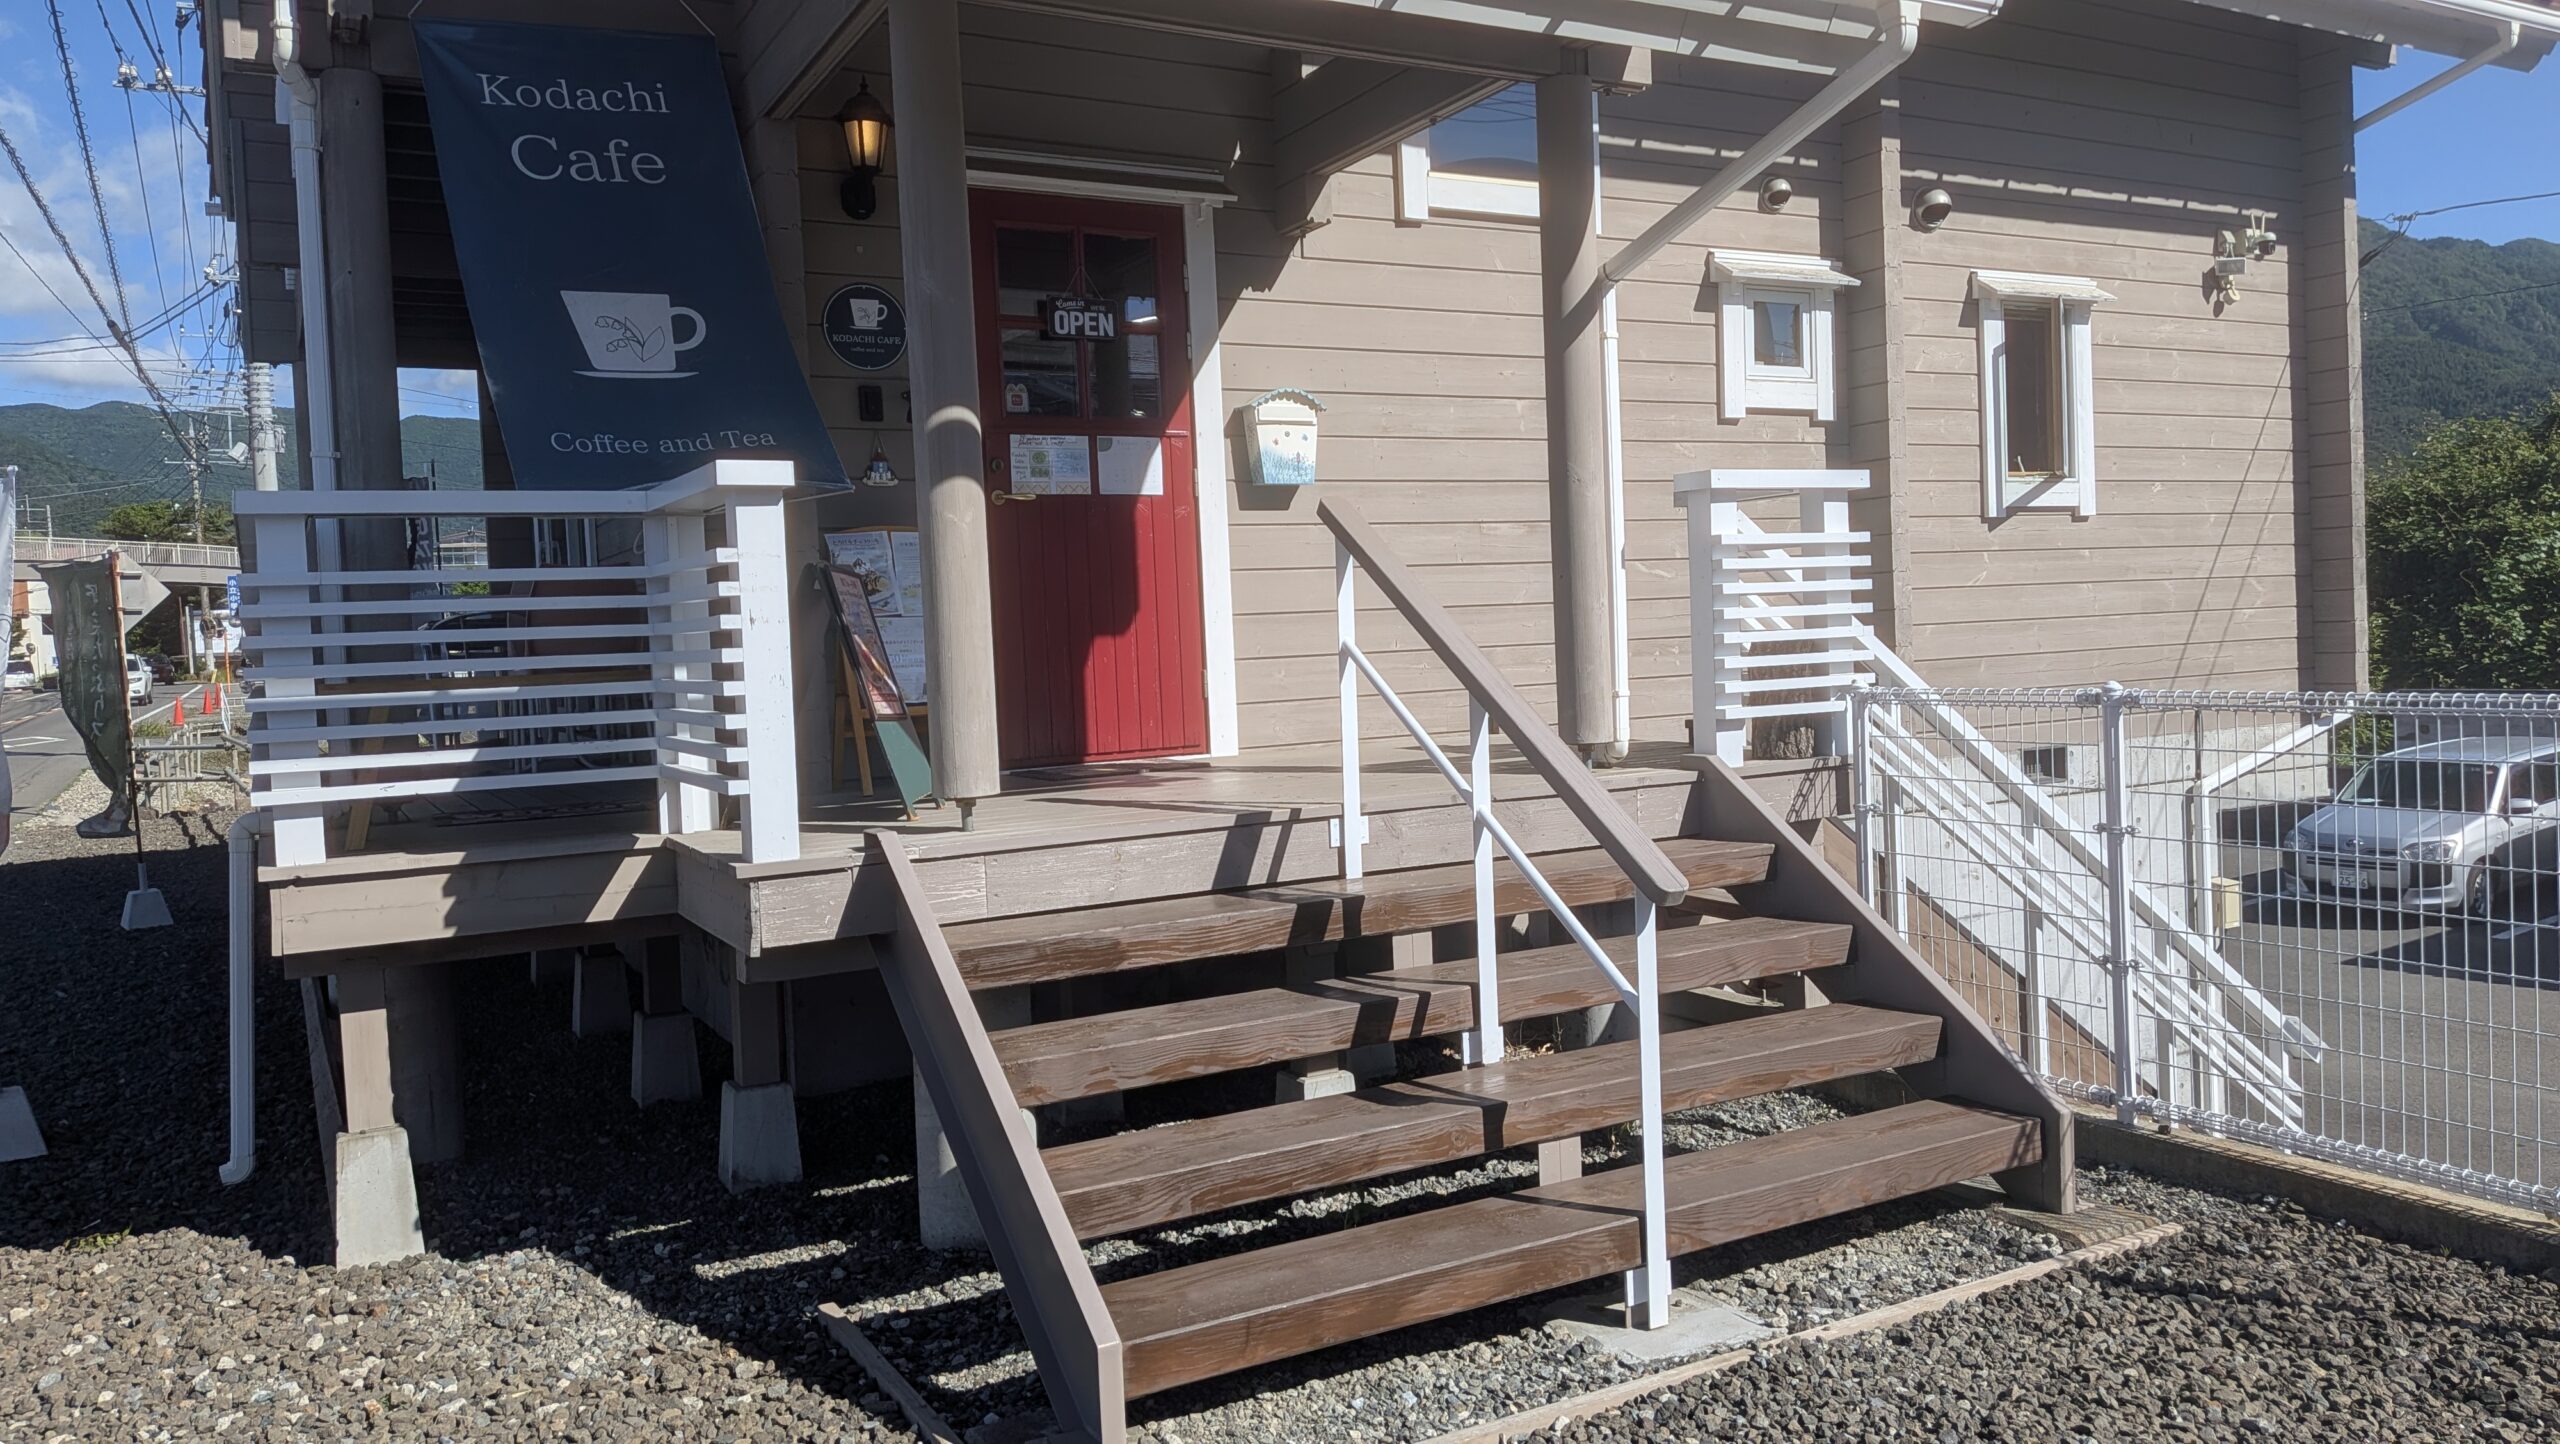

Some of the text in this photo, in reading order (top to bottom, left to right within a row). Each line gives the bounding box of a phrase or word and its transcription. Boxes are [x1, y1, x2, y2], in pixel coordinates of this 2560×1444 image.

[475, 73, 672, 114] Kodachi
[510, 133, 668, 184] Cafe
[1054, 310, 1115, 337] OPEN
[832, 334, 902, 345] KODACHI CAFE
[550, 430, 778, 455] Coffee and Tea
